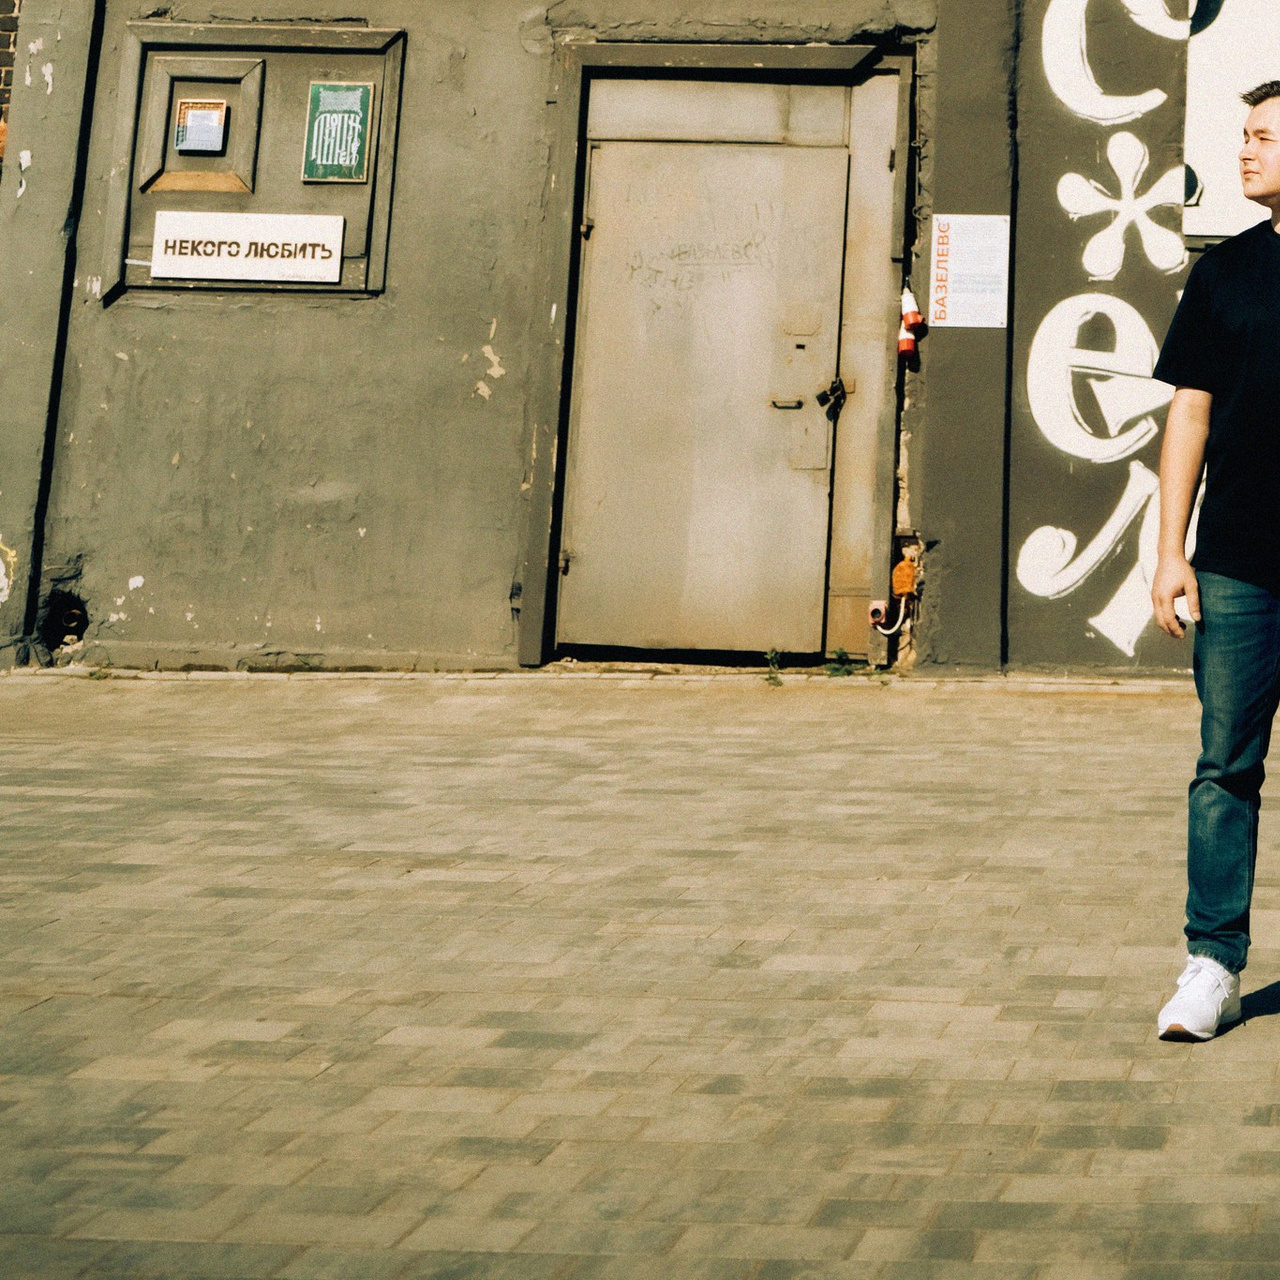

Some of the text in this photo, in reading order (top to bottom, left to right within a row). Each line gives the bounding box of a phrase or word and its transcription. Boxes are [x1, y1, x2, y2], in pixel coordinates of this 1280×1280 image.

[164, 239, 333, 260] НЕКОГО ЛЮБИТЬ
[934, 222, 950, 321] БАЗЕЛЕВС
